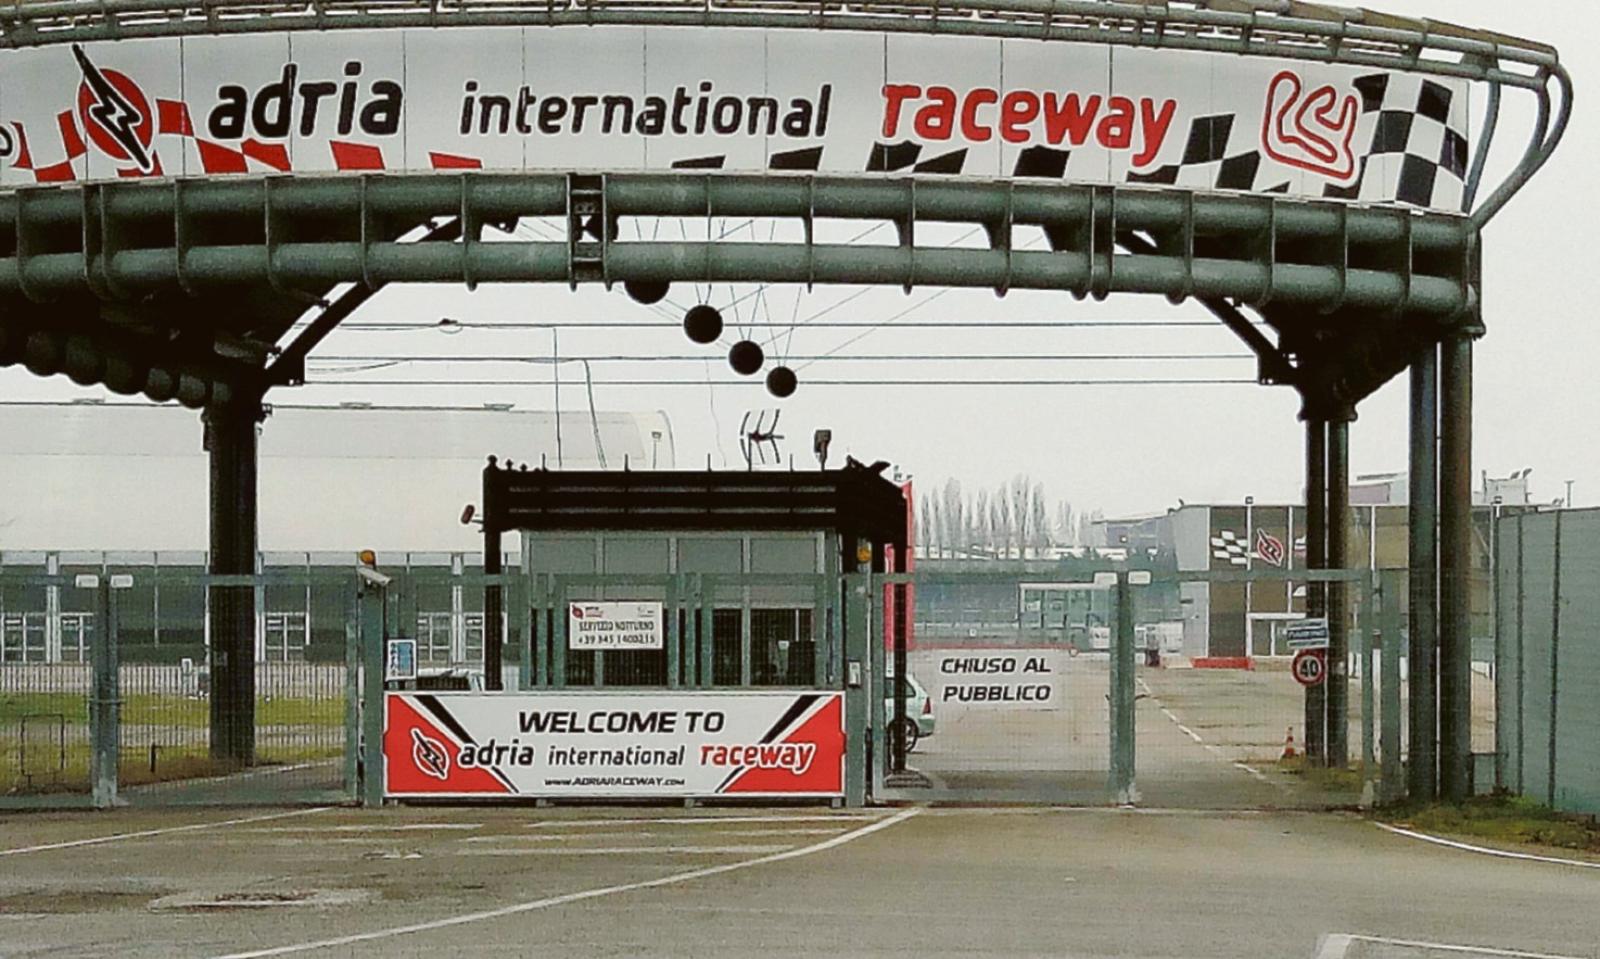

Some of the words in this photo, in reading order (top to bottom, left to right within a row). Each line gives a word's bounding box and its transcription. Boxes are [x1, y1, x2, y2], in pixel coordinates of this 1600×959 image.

[208, 61, 403, 139] adria
[460, 81, 832, 137] international
[882, 84, 1177, 168] raceway
[615, 621, 655, 631] NOTTURNO
[941, 658, 1016, 673] CHIUSO
[1023, 658, 1051, 672] AL
[1300, 659, 1319, 677] 40
[943, 685, 1051, 702] PUBBLICO
[519, 711, 677, 733] WELCOME
[685, 711, 725, 733] TO
[459, 738, 534, 766] adria
[549, 745, 685, 766] international
[700, 745, 814, 771] raceway
